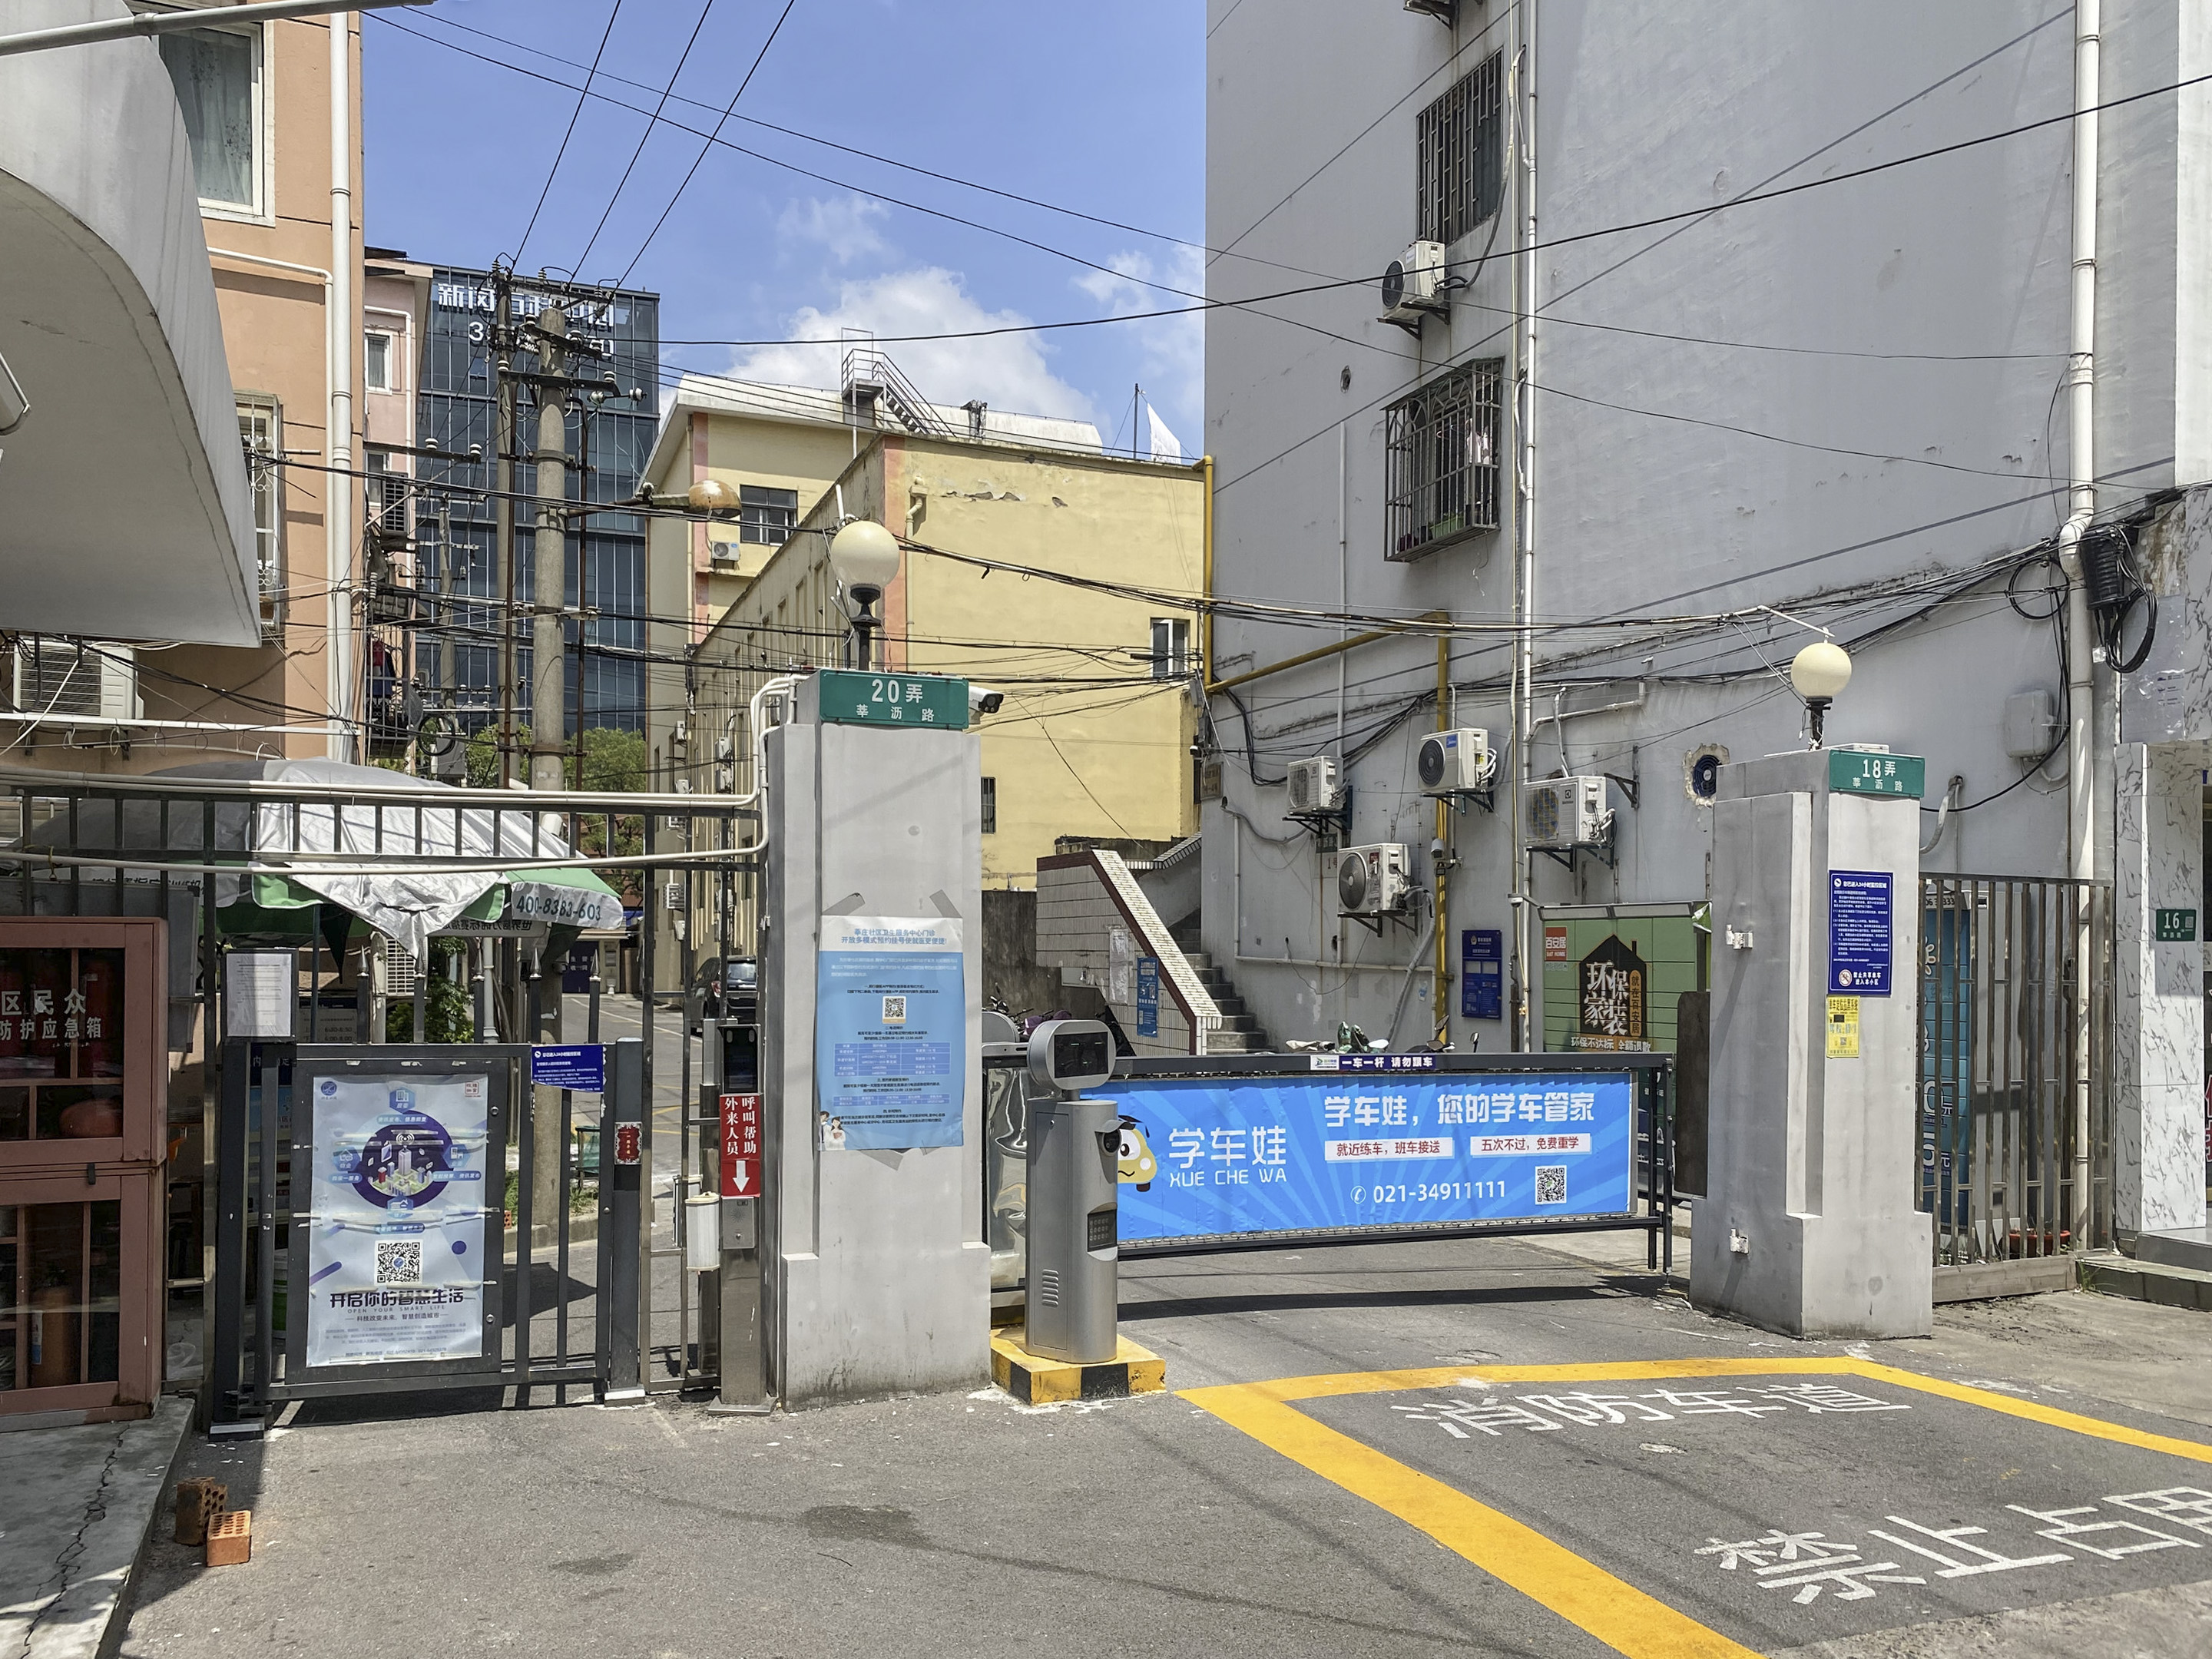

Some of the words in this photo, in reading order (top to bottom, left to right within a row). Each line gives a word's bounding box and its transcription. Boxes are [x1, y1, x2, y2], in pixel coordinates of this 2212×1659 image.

[871, 678, 923, 704] 20弄
[856, 704, 935, 723] 莘沥路
[1863, 758, 1896, 779] 18弄
[1852, 777, 1903, 792] 莘沥路
[516, 895, 601, 921] 400-8383-603
[2164, 912, 2180, 929] 16
[1545, 936, 1567, 949] 百安居
[1586, 961, 1629, 1001] 环保
[2, 988, 86, 1015] 区民众
[1584, 991, 1629, 1036] 家装
[1631, 975, 1640, 1034] 就在百安居
[0, 1016, 101, 1041] 防护应急箱
[1571, 1036, 1614, 1050] 环保不达标
[1342, 1057, 1385, 1068] 一车一杆
[1391, 1057, 1433, 1068] 请勿跟车
[724, 1097, 740, 1156] 外来人员
[741, 1096, 757, 1154] 呼叫帮助
[1167, 1124, 1287, 1169] 学车娃
[1336, 1139, 1441, 1157] 就近练车，班车接送
[1480, 1136, 1579, 1152] 五次不过，免费重学
[1169, 1171, 1205, 1188] XUE
[1214, 1169, 1249, 1185] CHE
[1259, 1167, 1287, 1183] WA
[1373, 1180, 1506, 1204] 021-34911111
[329, 1287, 464, 1309] 开启你的智慧生活
[1390, 1382, 1913, 1439] 消防车道
